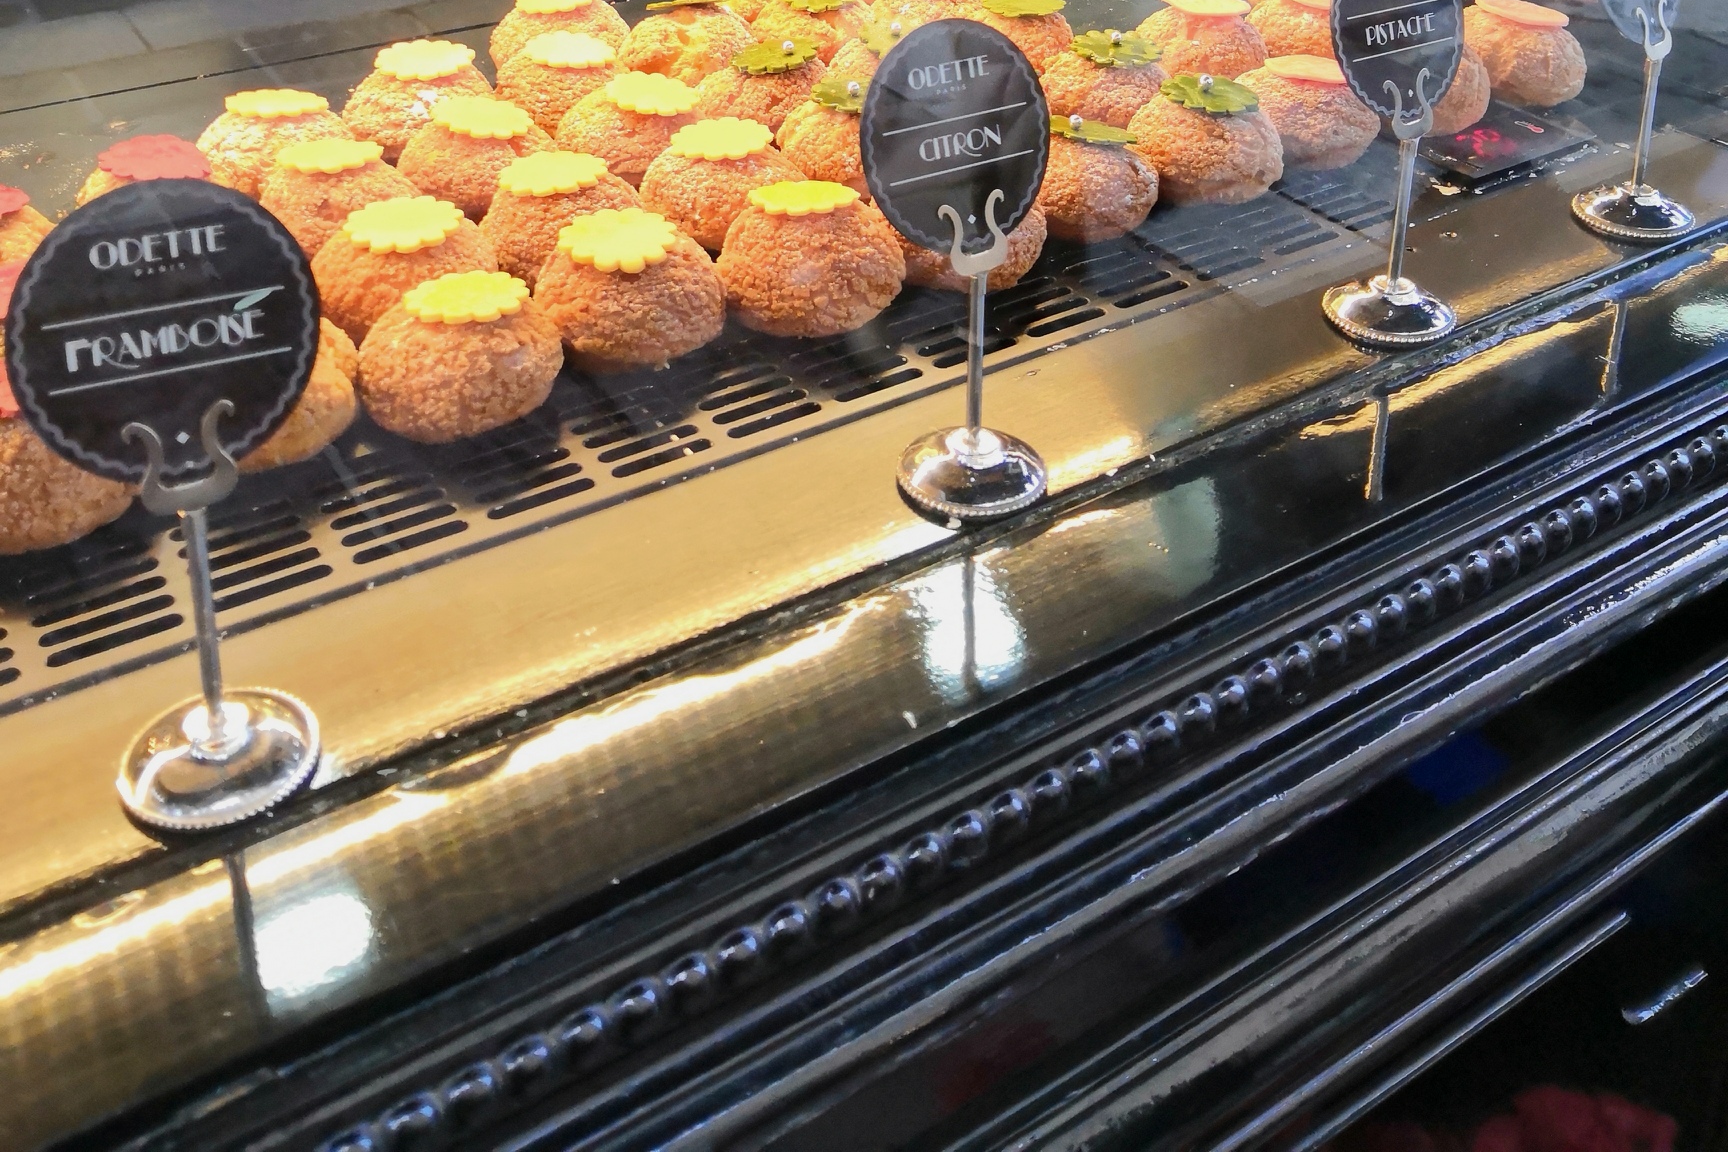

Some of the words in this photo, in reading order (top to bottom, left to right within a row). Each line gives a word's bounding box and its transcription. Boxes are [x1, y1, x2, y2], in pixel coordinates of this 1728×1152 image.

[1364, 12, 1436, 46] PISTACHE
[907, 54, 990, 91] ODETTE
[935, 83, 968, 96] PARIS
[918, 123, 1002, 163] CITRON
[88, 224, 227, 270] ODETTE
[64, 308, 266, 374] FRAMBOISE
